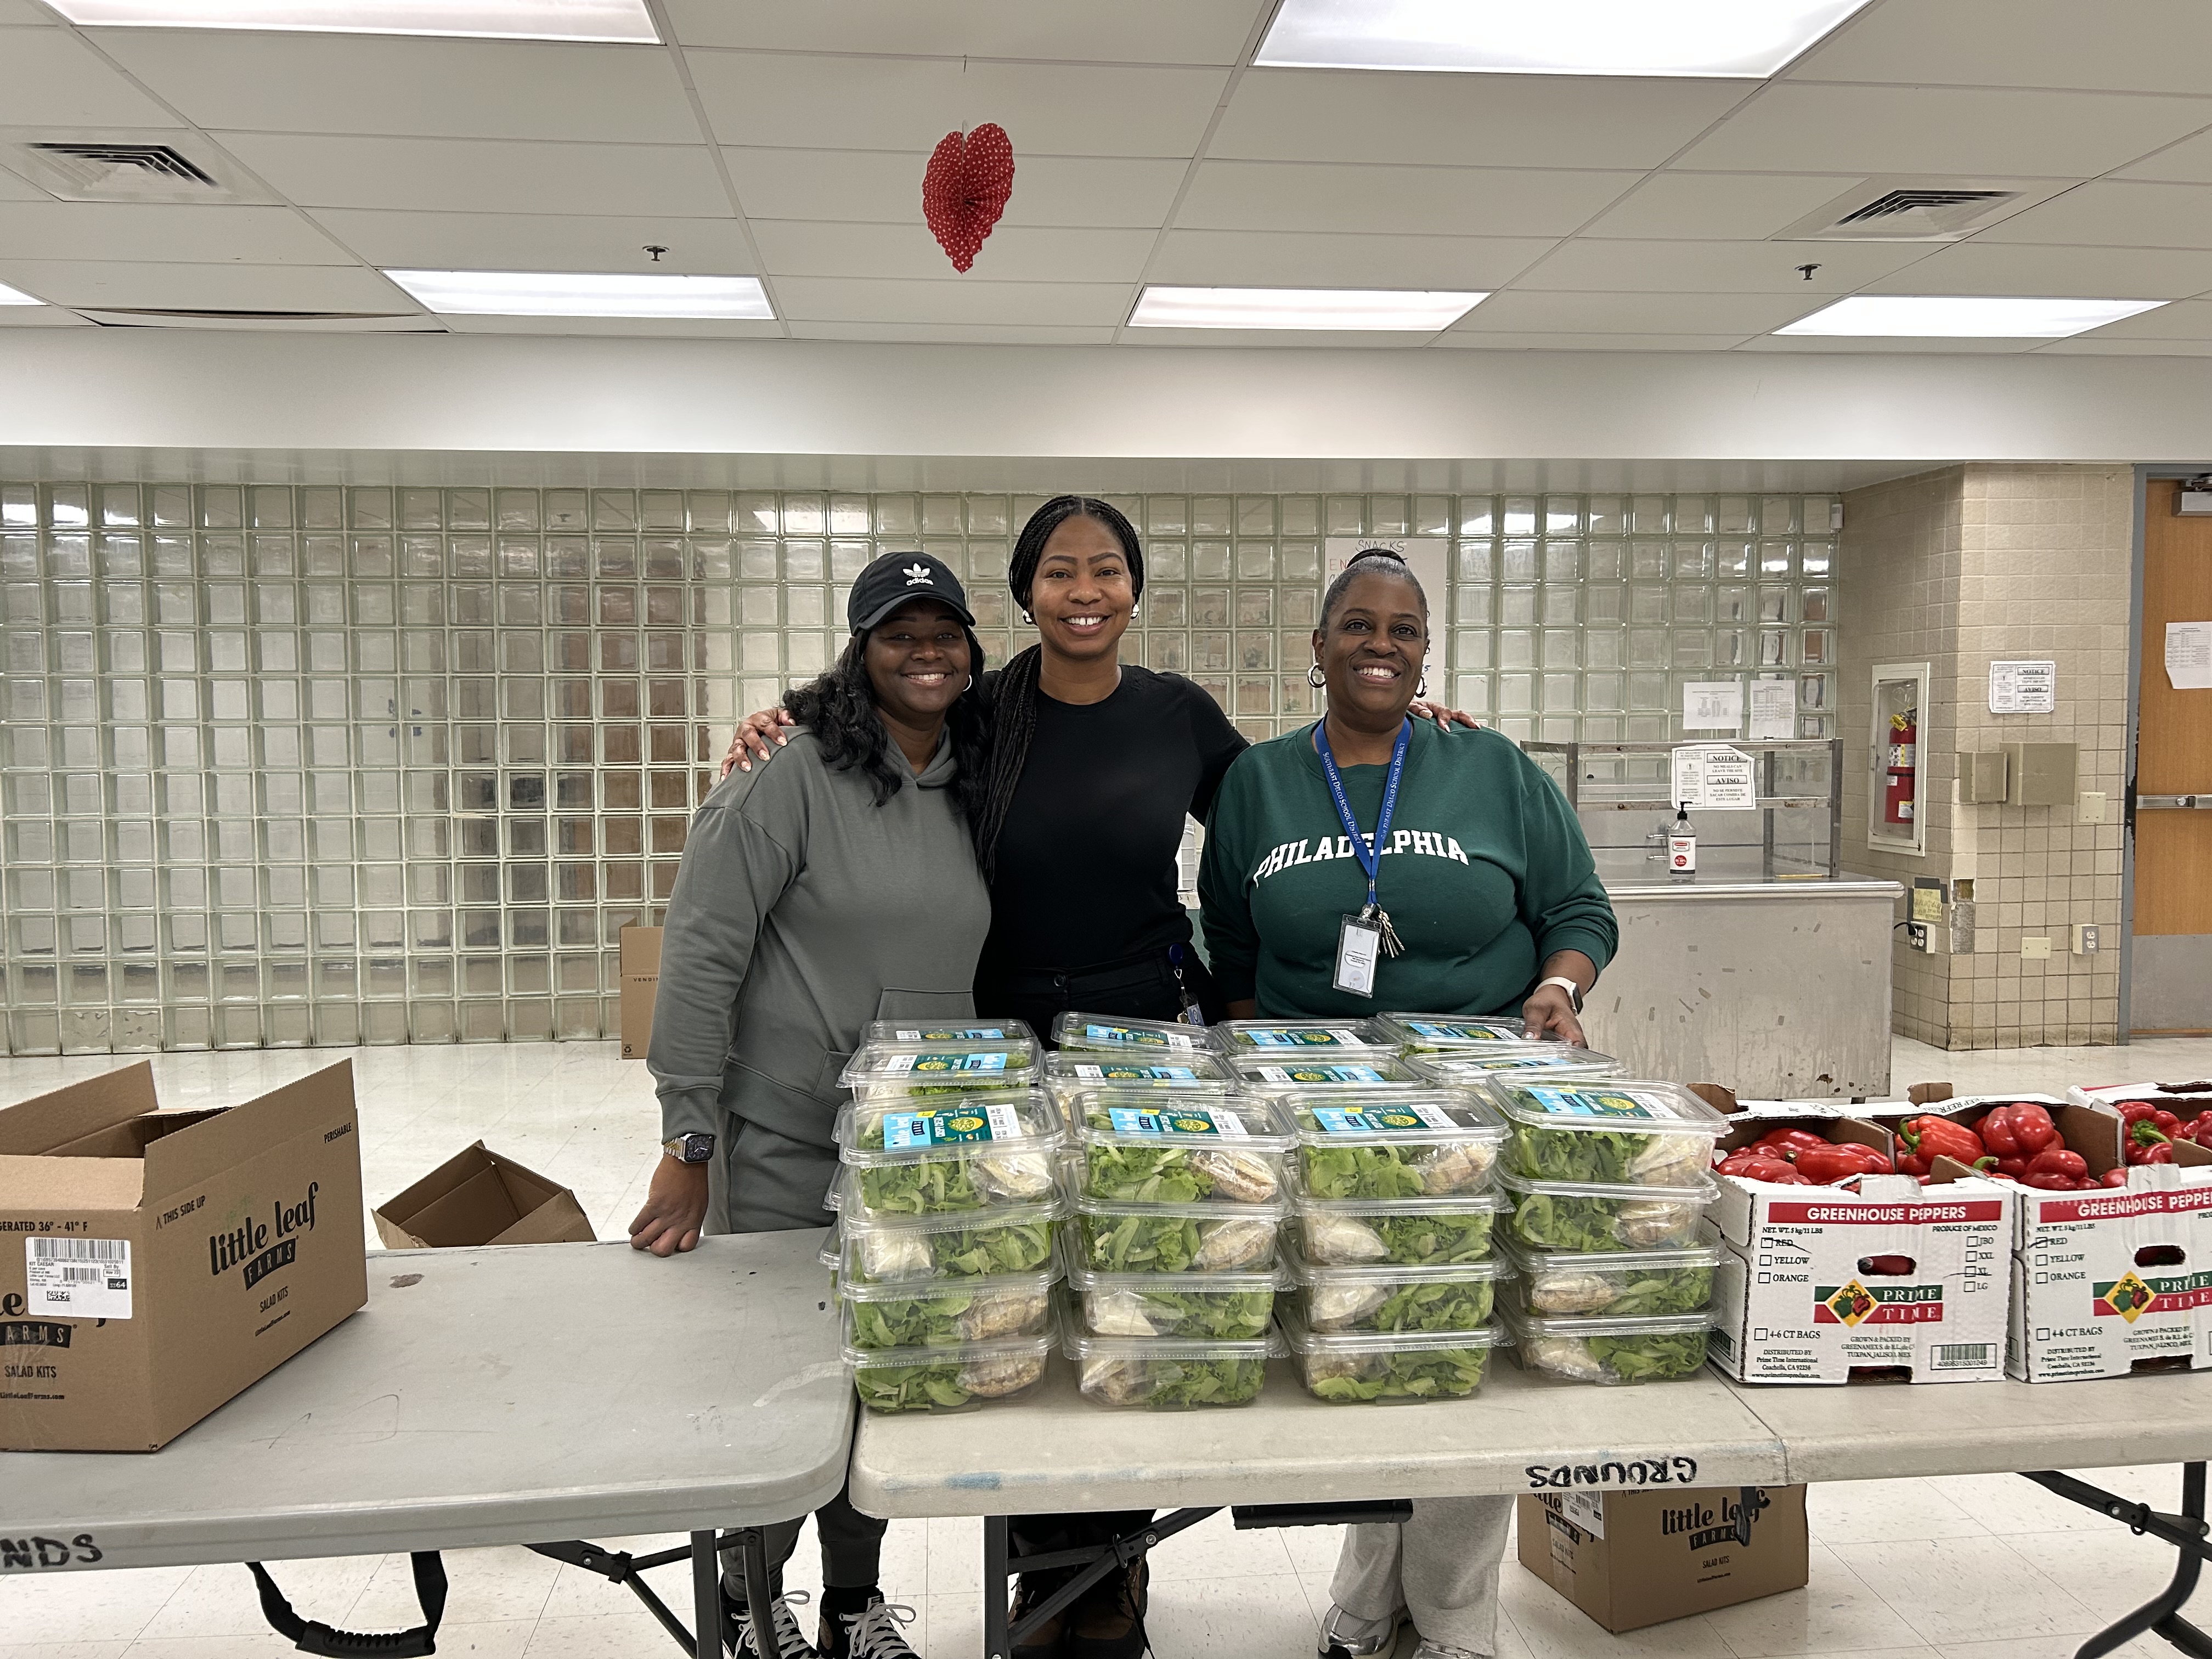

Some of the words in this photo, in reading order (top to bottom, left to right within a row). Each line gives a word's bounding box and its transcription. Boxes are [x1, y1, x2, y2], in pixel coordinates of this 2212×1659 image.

[1355, 539, 1406, 552] SNACKS
[906, 578, 934, 586] adidas
[324, 1122, 352, 1144] PERISHABLE
[163, 1211, 178, 1225] THIS
[180, 1203, 195, 1217] SIDE
[194, 1195, 206, 1211] UP
[2079, 1195, 2163, 1217] GREENHOUSE
[1807, 1207, 1904, 1221] GREENHOUSE
[1909, 1206, 1966, 1221] PEPPERS
[83, 1221, 87, 1232] F
[210, 1217, 268, 1276] little
[274, 1181, 319, 1238] leaf
[247, 1243, 292, 1284] FARMS
[2050, 1254, 2085, 1262] YELLOW
[1773, 1274, 1809, 1282] ORANGE
[2050, 1272, 2086, 1281] ORANGE
[260, 1293, 276, 1313] SALAD
[276, 1286, 289, 1302] KITS
[1883, 1289, 1937, 1301] PRIME
[1796, 1330, 1820, 1339] BAGS
[2079, 1327, 2103, 1336] BAGS
[4, 1365, 33, 1378] SALAD
[36, 1366, 57, 1378] KITS
[1525, 1456, 1697, 1488] GROUNDS
[1662, 1503, 1715, 1536] little
[1694, 1527, 1735, 1547] FARMS
[1702, 1558, 1718, 1568] SALAD
[1719, 1556, 1730, 1565] KITS
